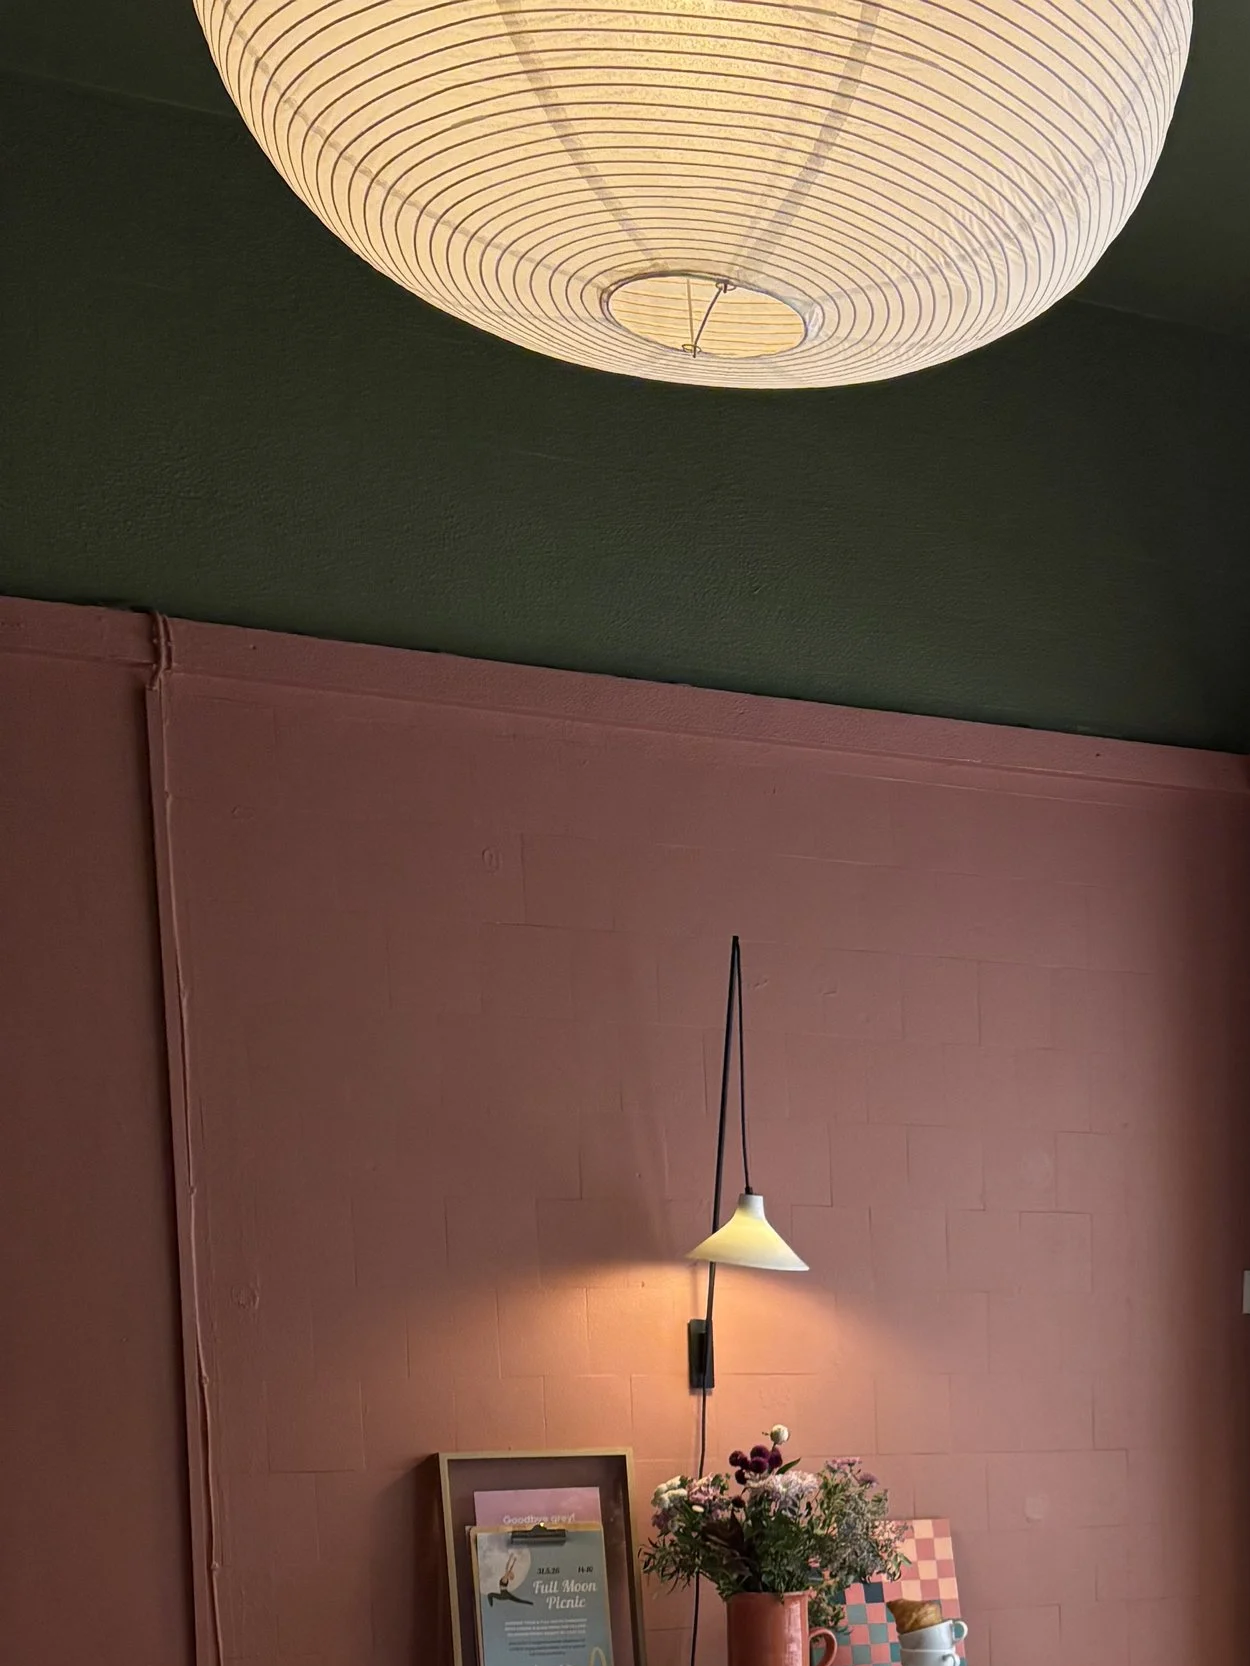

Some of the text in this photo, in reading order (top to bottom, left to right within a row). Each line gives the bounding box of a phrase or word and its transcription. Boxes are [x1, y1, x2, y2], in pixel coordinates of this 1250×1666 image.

[532, 1579, 597, 1594] Full Moon
[545, 1595, 587, 1610] Picnic
